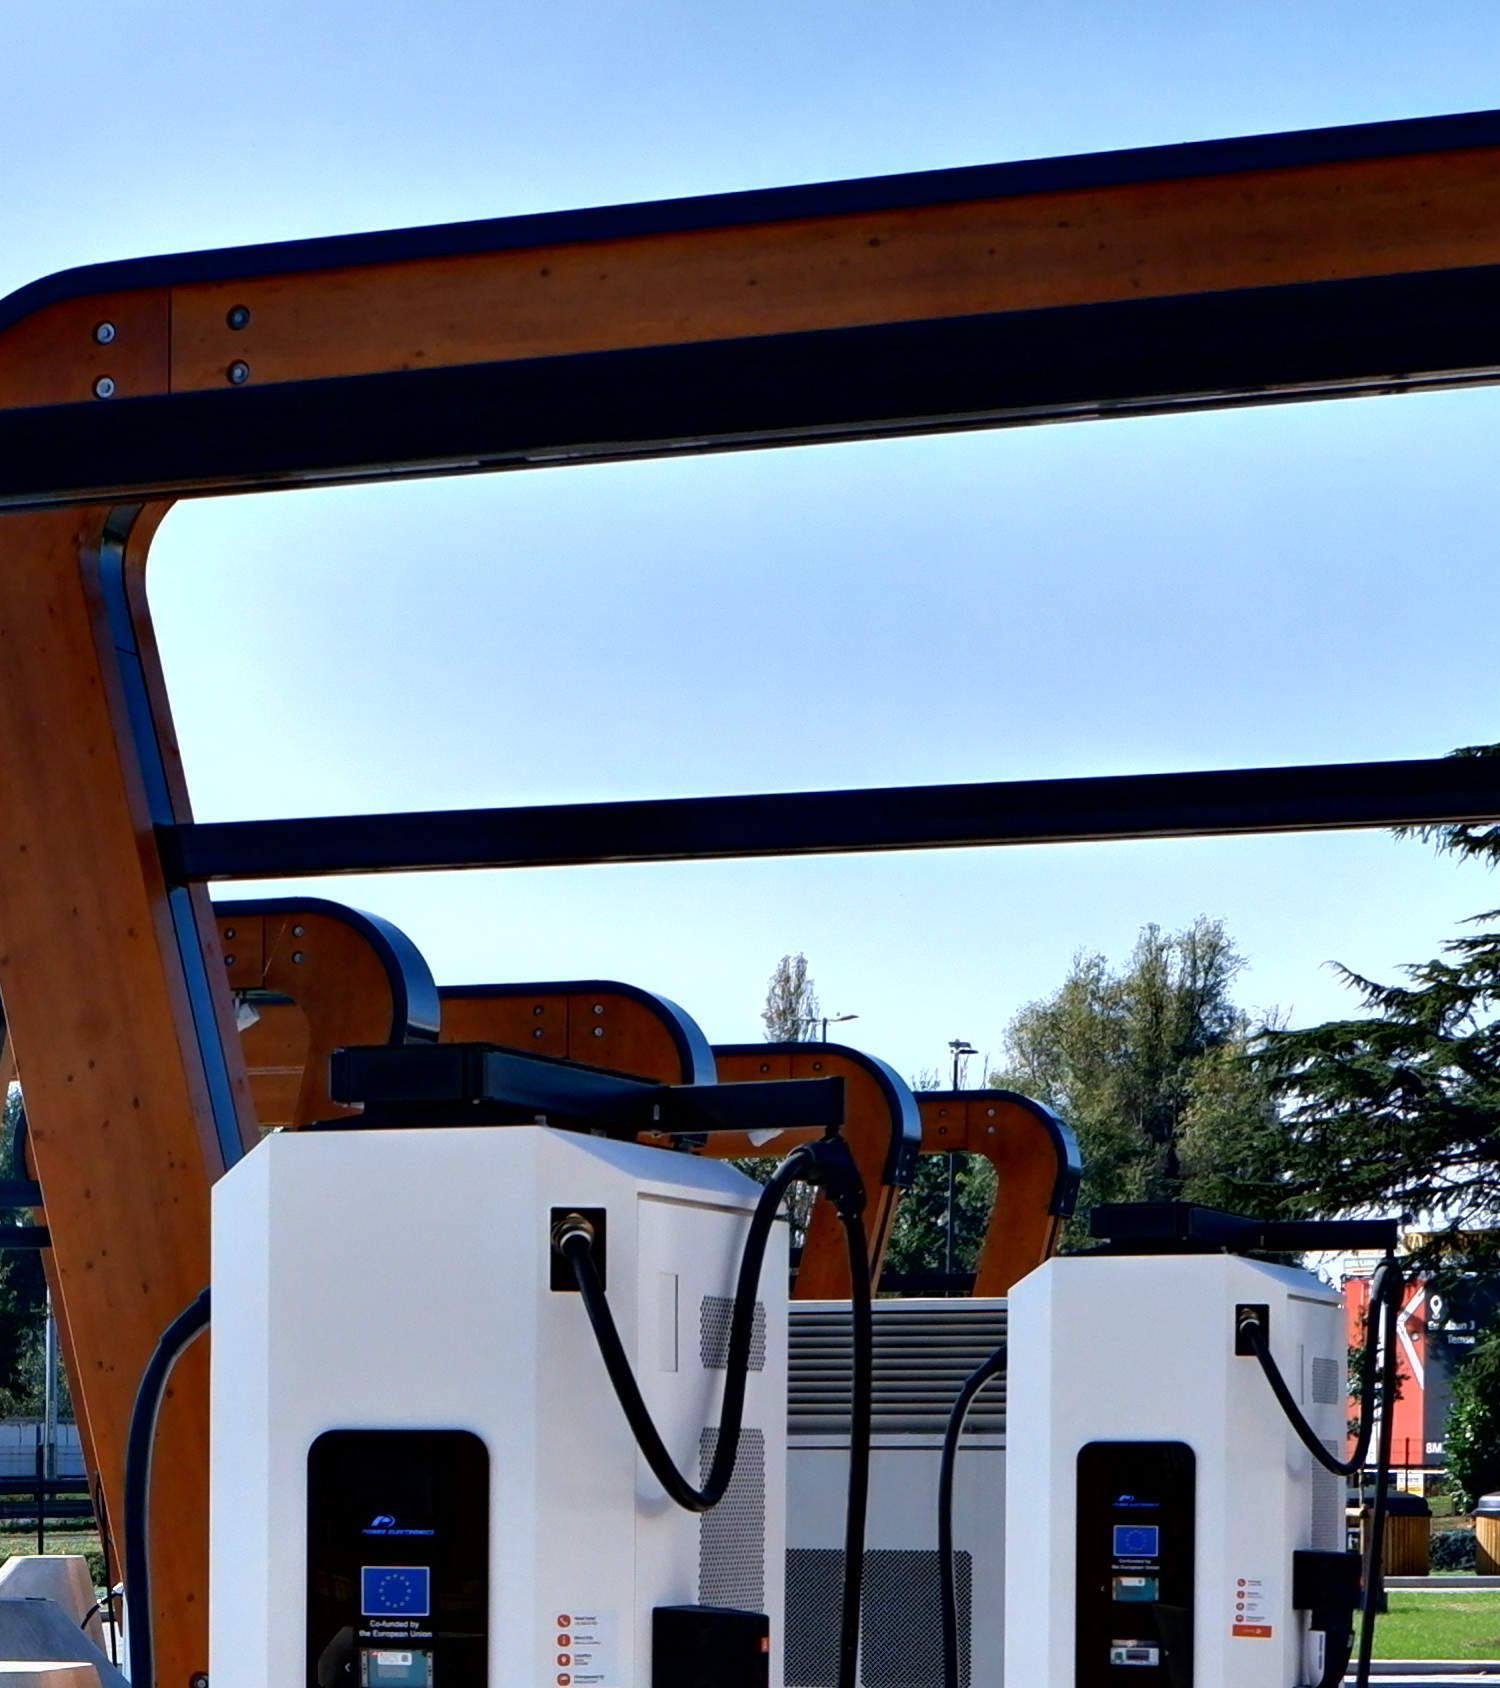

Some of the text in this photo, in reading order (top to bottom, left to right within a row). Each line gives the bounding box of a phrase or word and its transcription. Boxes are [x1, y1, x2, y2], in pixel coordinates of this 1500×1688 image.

[369, 1619, 420, 1630] Co-funded by
[372, 1630, 408, 1638] European
